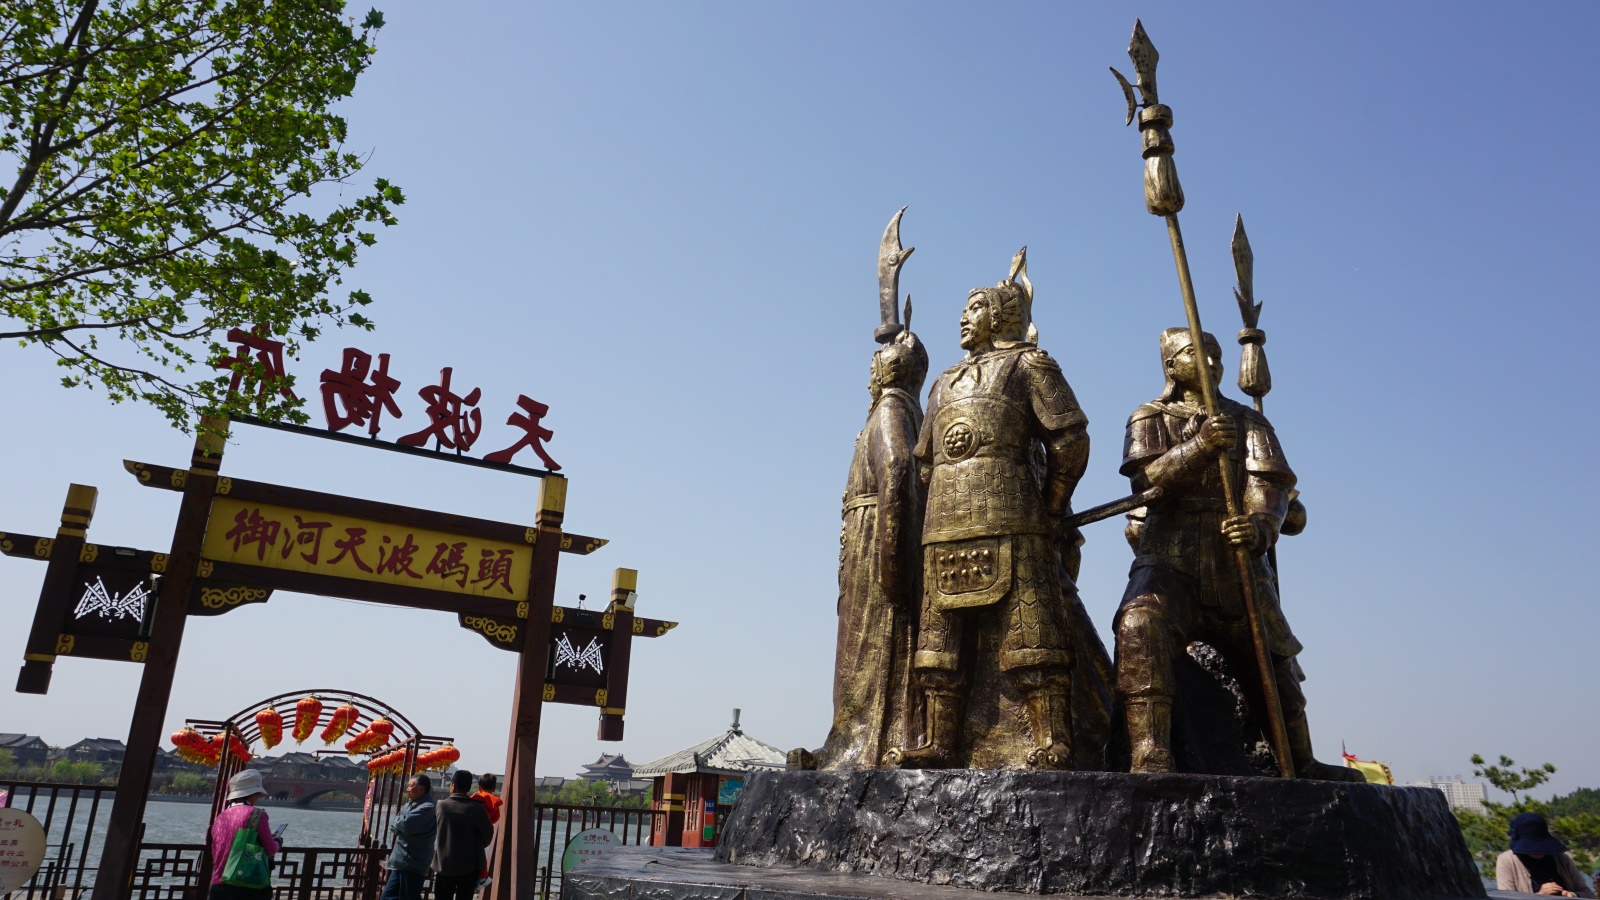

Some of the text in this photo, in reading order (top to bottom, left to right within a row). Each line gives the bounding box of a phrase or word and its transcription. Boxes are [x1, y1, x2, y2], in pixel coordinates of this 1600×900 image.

[226, 508, 514, 595] 御河天波碼頭
